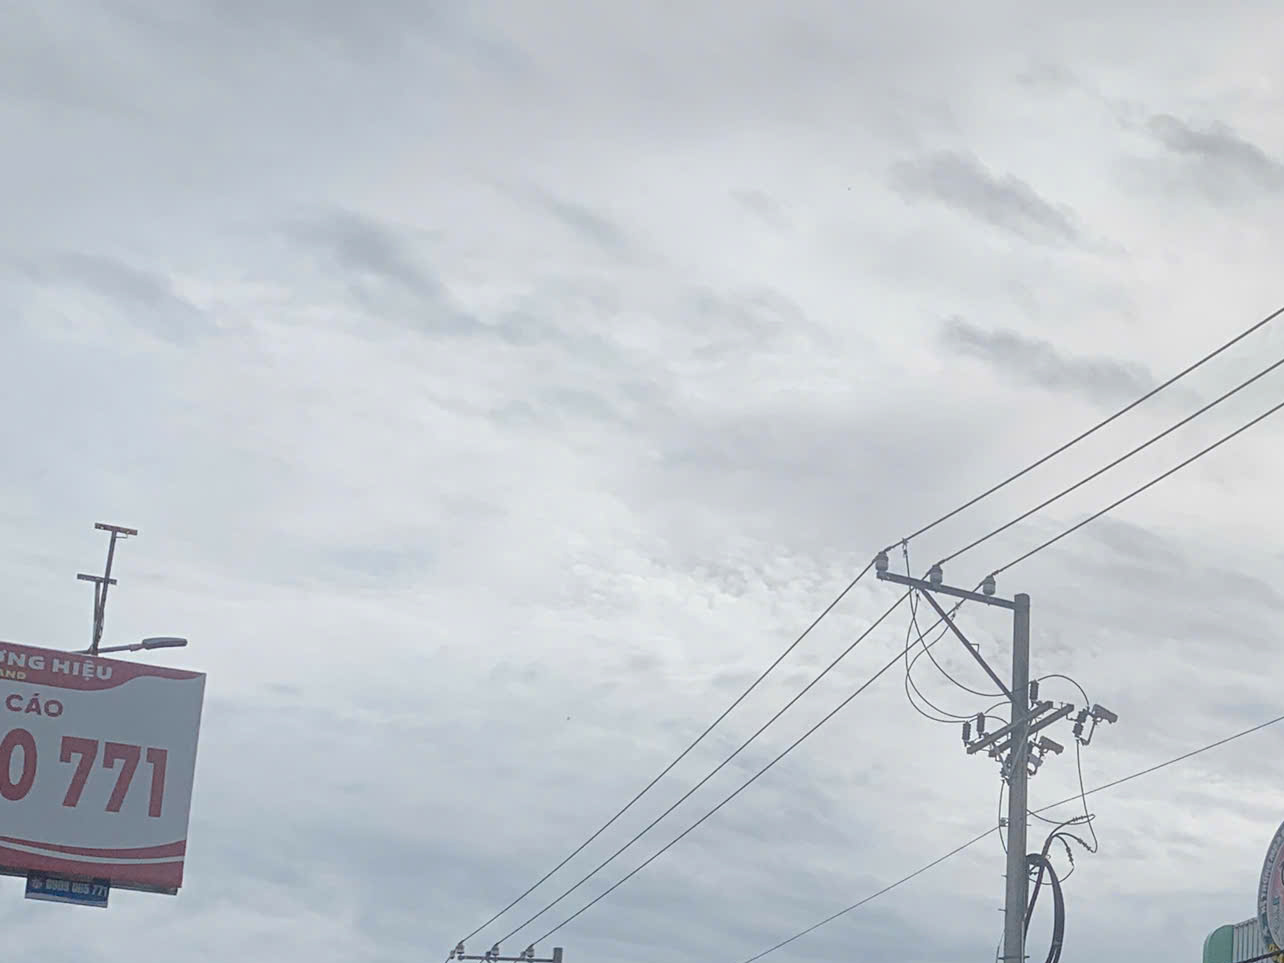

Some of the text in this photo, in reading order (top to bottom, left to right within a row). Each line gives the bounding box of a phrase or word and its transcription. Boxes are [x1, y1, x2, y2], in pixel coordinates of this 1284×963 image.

[52, 659, 113, 680] HIỆU
[5, 693, 63, 717] CÁO
[59, 735, 168, 819] 771
